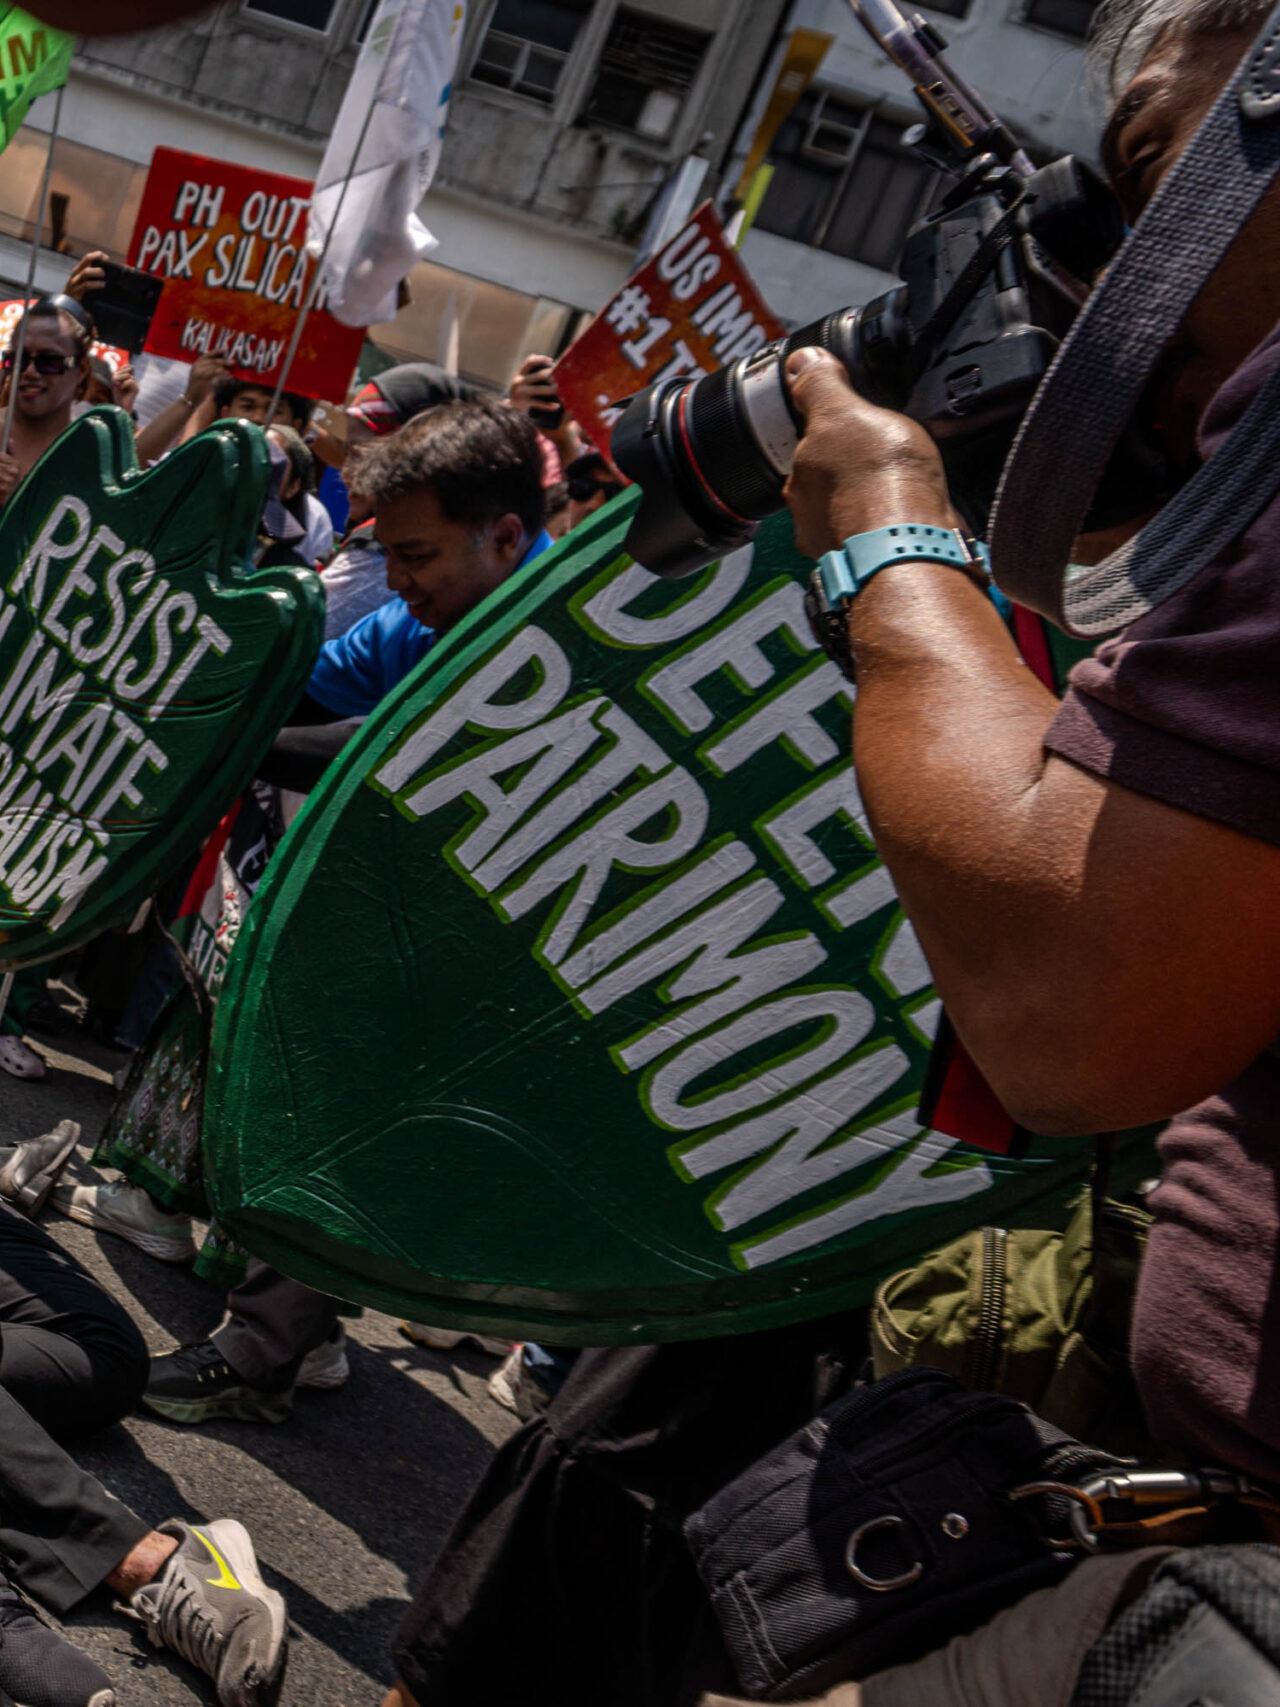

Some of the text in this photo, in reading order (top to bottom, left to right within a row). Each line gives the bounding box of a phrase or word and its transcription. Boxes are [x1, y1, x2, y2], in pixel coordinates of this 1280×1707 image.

[173, 180, 312, 241] PH OUT
[135, 225, 210, 278] PAX
[206, 234, 309, 309] SILICA
[658, 222, 767, 367] US IMP
[181, 317, 286, 373] KALIKASAN
[606, 285, 709, 384] #1 T
[10, 493, 233, 723] RESIST
[378, 624, 995, 1269] PATRIMONY
